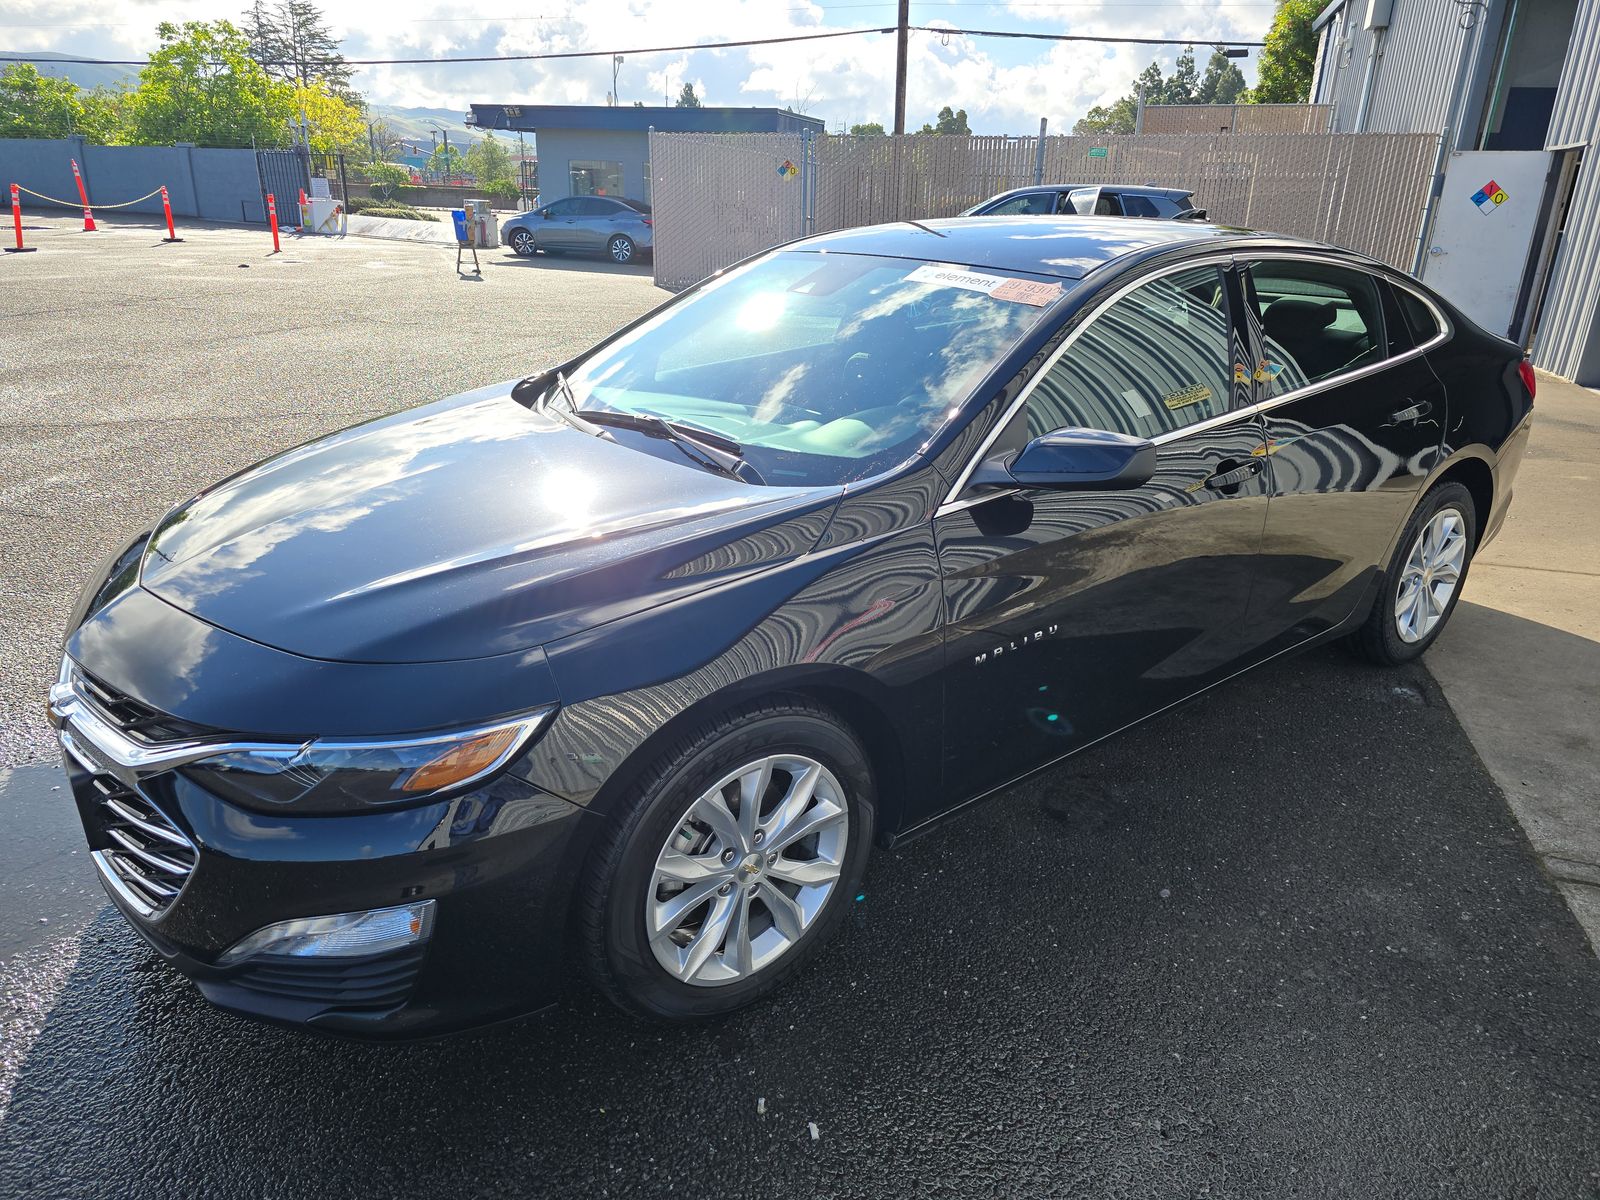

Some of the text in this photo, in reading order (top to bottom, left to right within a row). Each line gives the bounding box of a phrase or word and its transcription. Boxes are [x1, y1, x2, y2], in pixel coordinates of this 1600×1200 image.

[1475, 192, 1503, 204] 2 0
[934, 271, 997, 288] element
[975, 624, 1058, 664] MALIBU
